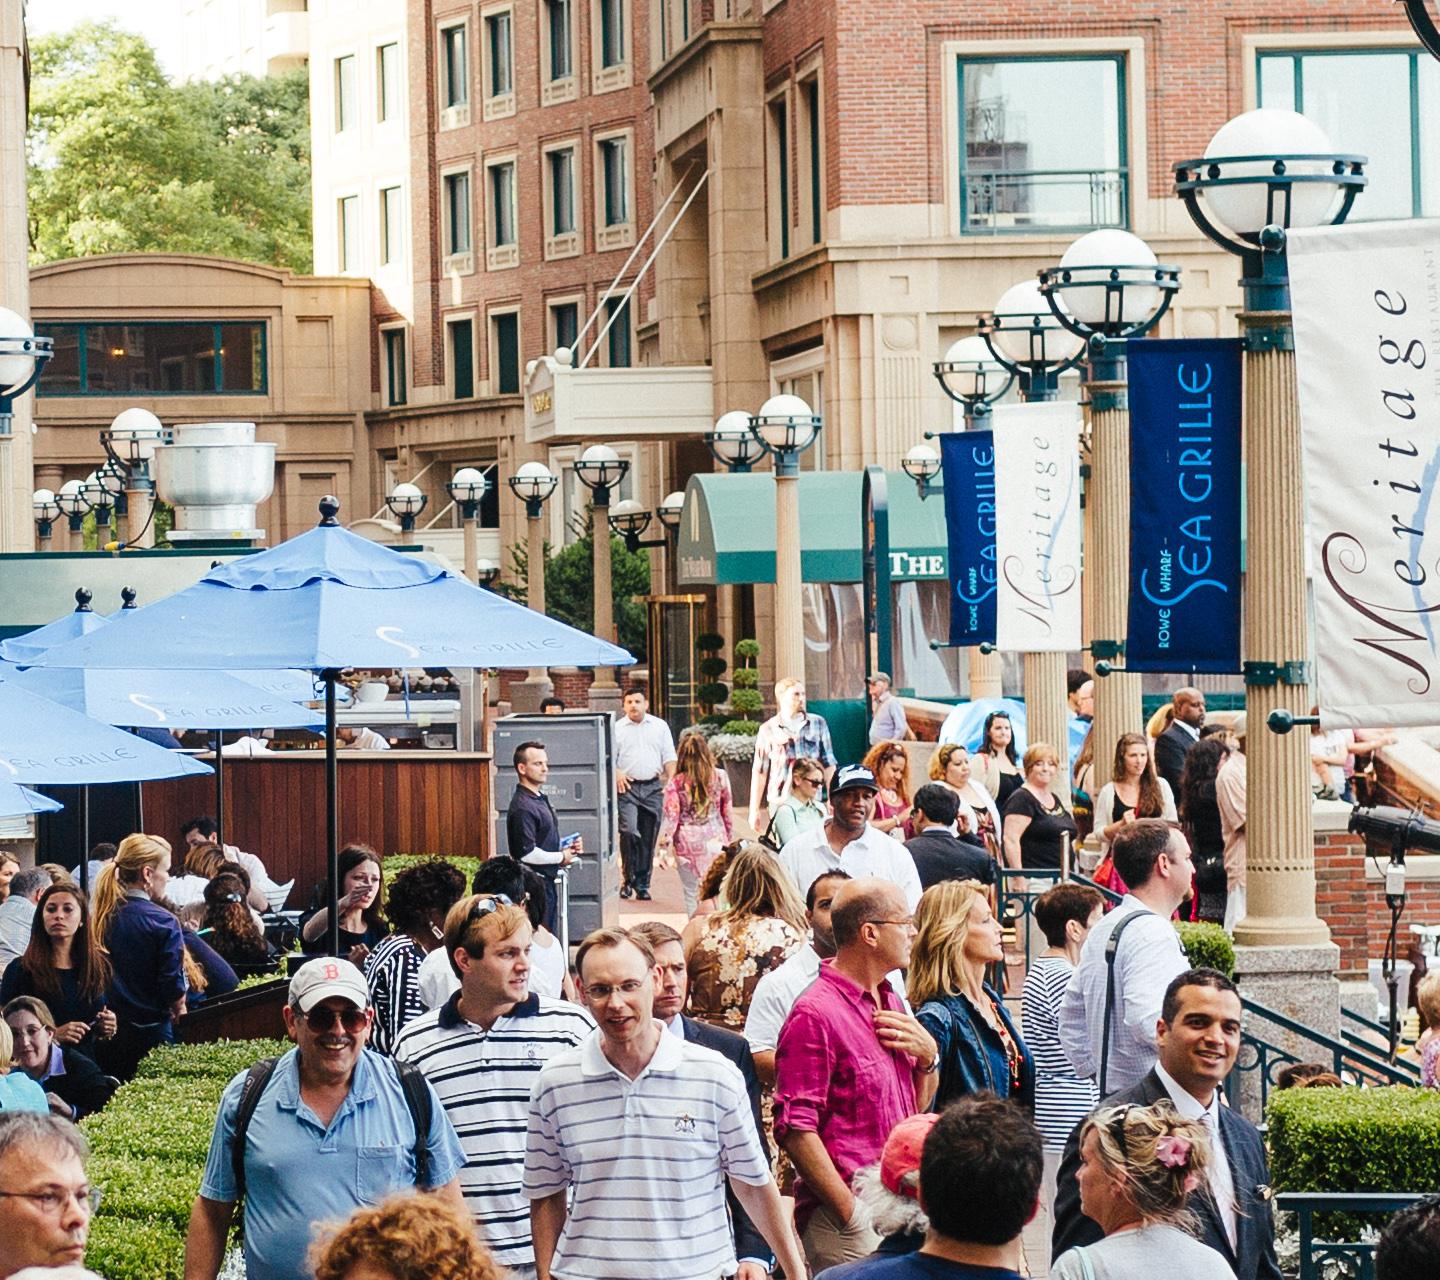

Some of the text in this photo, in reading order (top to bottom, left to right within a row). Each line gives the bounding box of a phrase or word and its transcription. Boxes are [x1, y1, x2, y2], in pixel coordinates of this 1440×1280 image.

[1141, 363, 1228, 606] SEA GRILLE
[888, 552, 945, 576] THE
[1003, 437, 1076, 637] Meritage
[1159, 550, 1172, 649] ROWE WHARF
[205, 704, 279, 718] GRILLE
[54, 747, 138, 769] GRILLE
